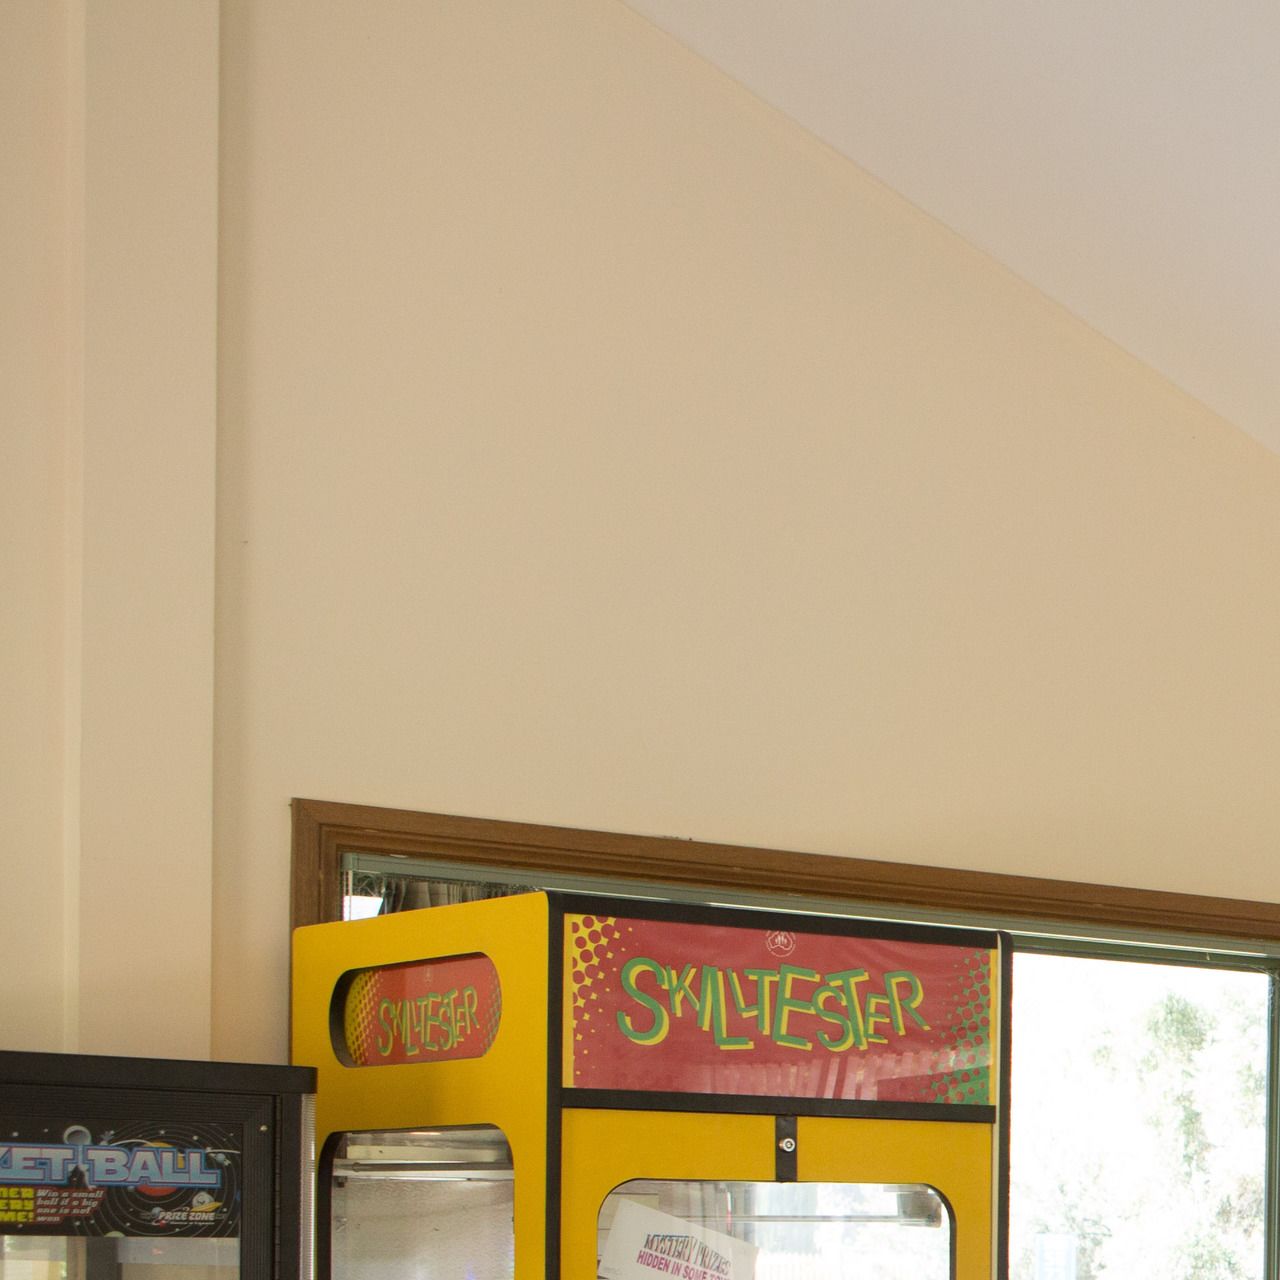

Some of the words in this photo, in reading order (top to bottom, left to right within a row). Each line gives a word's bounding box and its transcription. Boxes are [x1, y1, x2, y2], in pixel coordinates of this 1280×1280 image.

[617, 957, 931, 1052] SKILLTESTER
[87, 1149, 219, 1186] BALL
[636, 1250, 669, 1273] HIDDEN
[671, 1261, 681, 1277] IN
